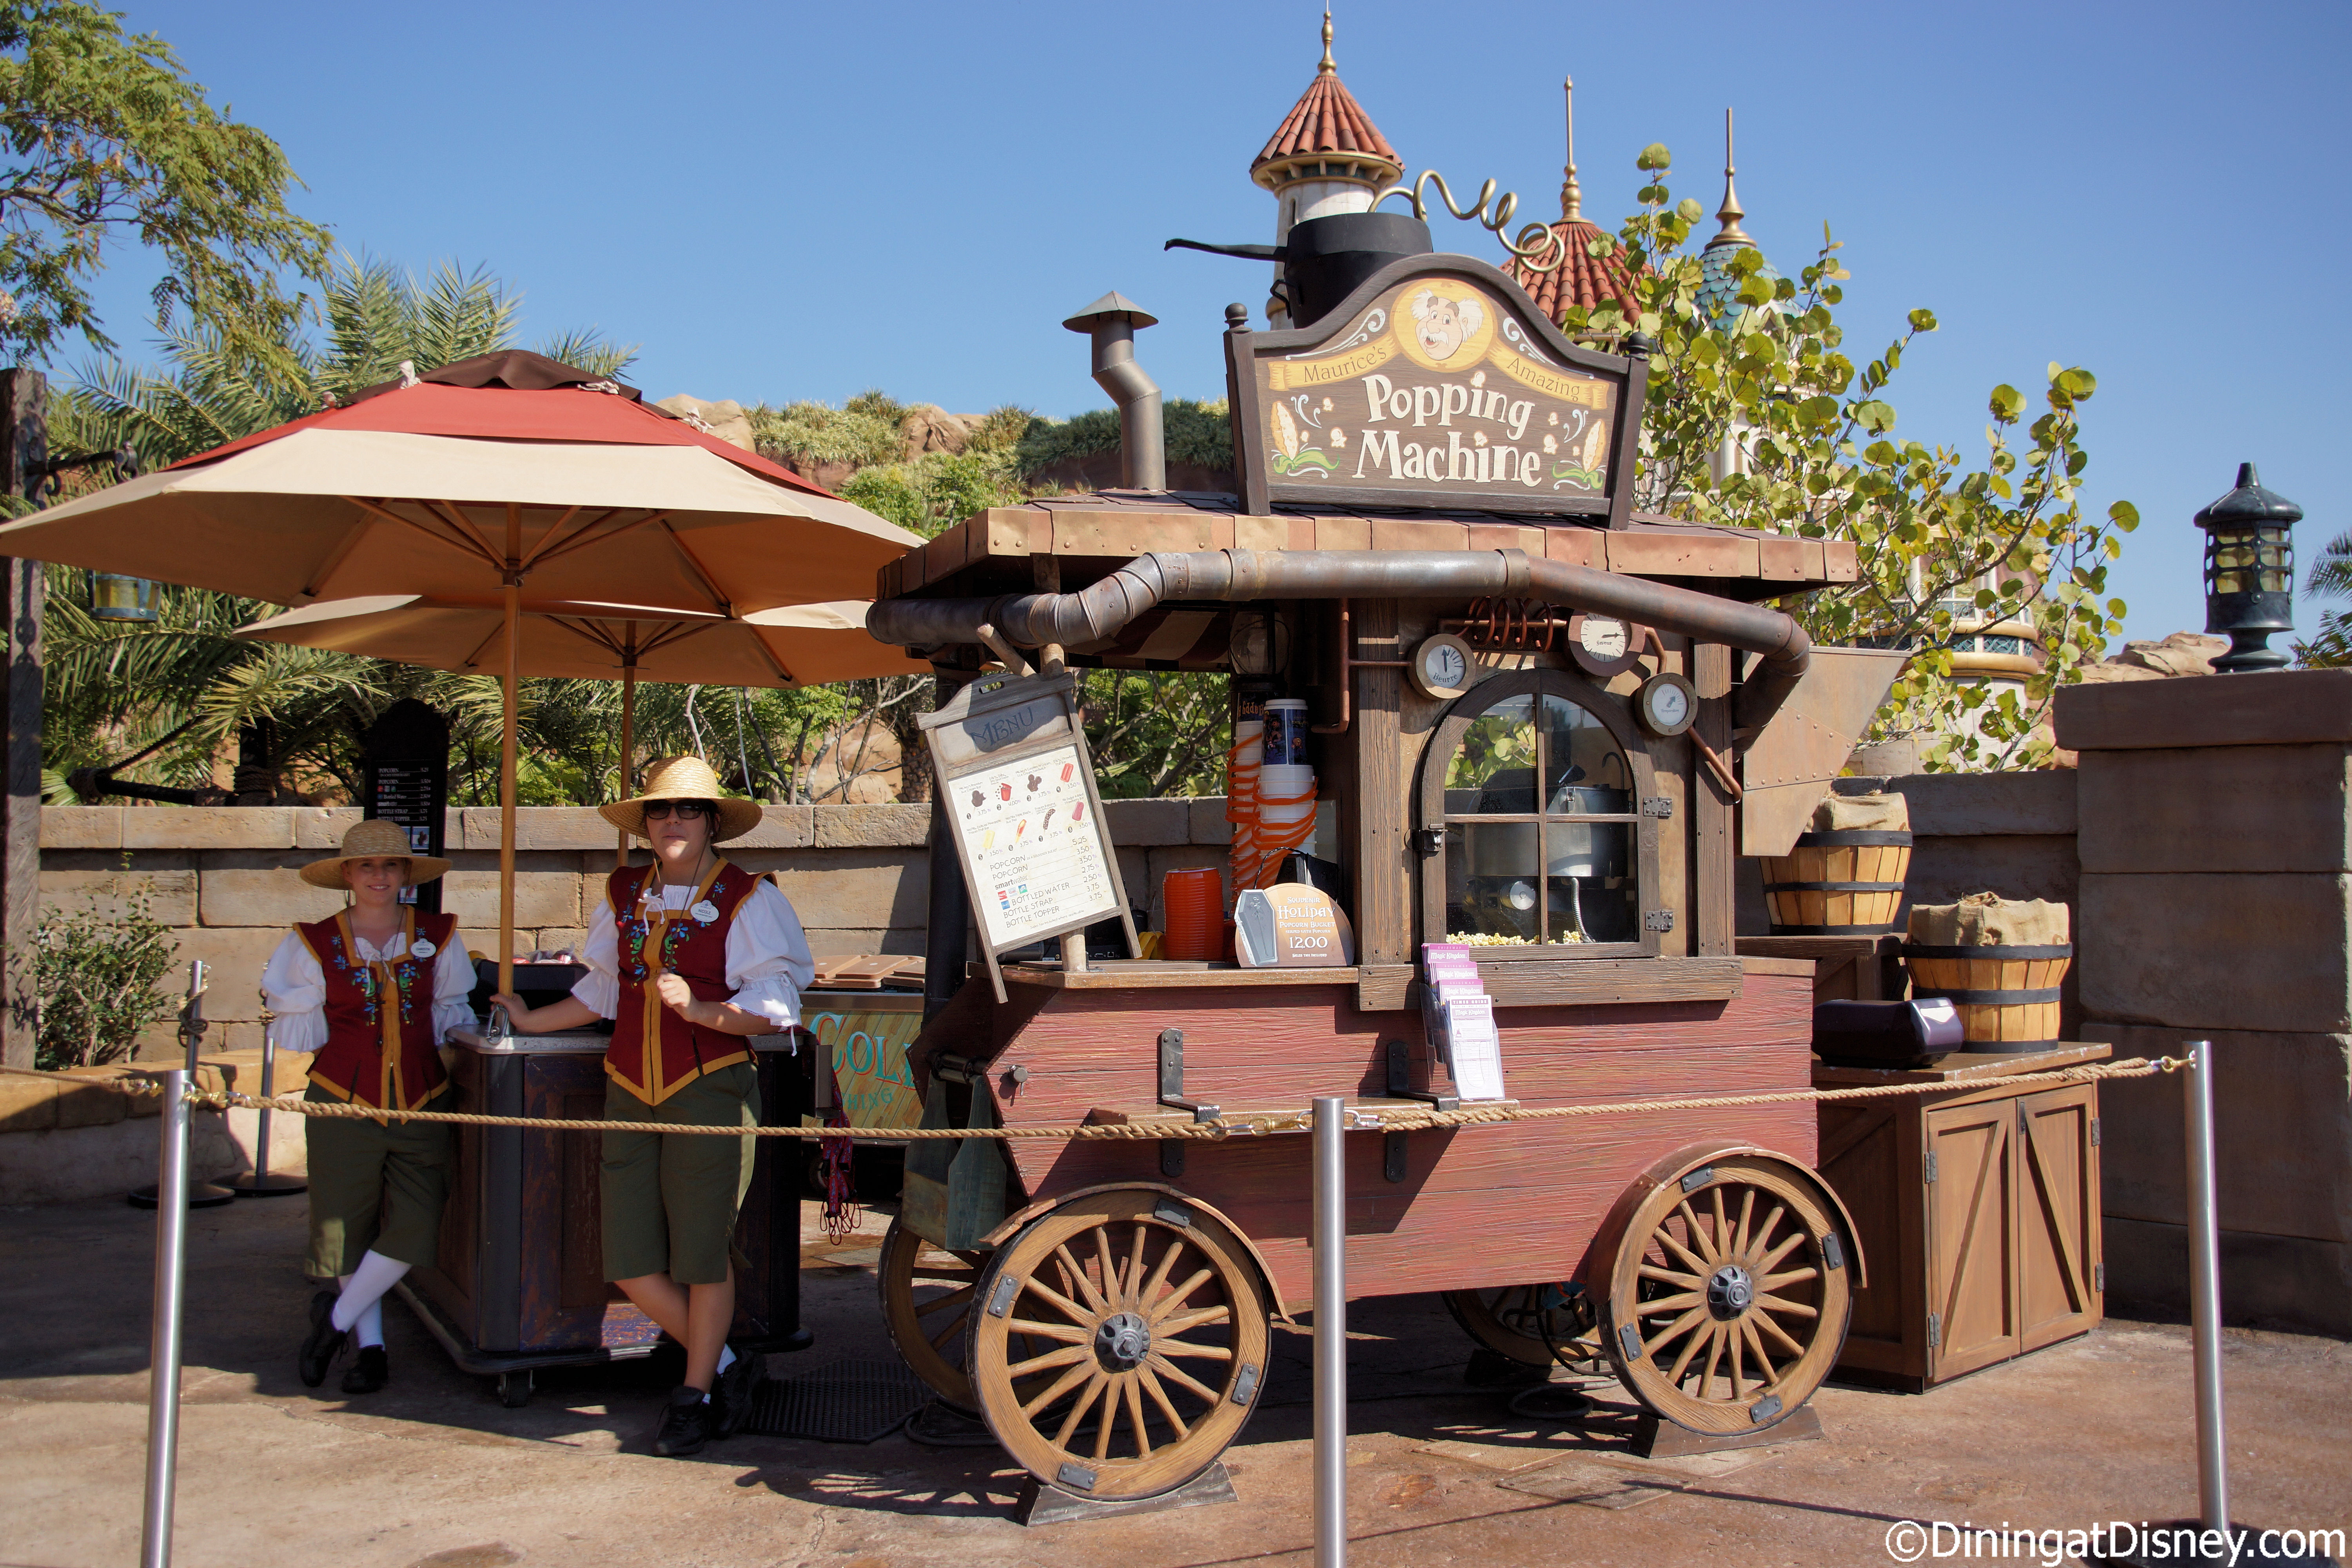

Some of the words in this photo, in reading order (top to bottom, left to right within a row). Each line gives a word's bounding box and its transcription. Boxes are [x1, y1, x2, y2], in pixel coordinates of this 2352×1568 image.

[1303, 346, 1388, 383] Maurice's
[1506, 357, 1580, 401] Amazing
[1361, 372, 1535, 440] Popping
[1352, 430, 1542, 487] Machine
[1433, 672, 1457, 682] Beurre
[969, 706, 1034, 754] MENU
[989, 854, 1025, 871] POPCORN
[1072, 835, 1087, 846] 5.25
[992, 864, 1028, 881] POPCORN
[1076, 845, 1089, 855] 3.50
[1081, 863, 1095, 873] 2.75
[995, 875, 1028, 890] smartwater
[1078, 855, 1092, 864] 3.50
[1011, 890, 1044, 906] BOTTLED
[1044, 882, 1070, 895] WATER
[1083, 873, 1097, 883] 2.50
[1003, 905, 1029, 919] BOTTLE
[1031, 897, 1053, 909] STRAP
[1087, 882, 1100, 892] 3.75
[1005, 915, 1033, 928] BOTTLE
[1033, 906, 1060, 918] TOPPER
[1089, 891, 1102, 901] 3.75
[1289, 936, 1328, 949] 12.00
